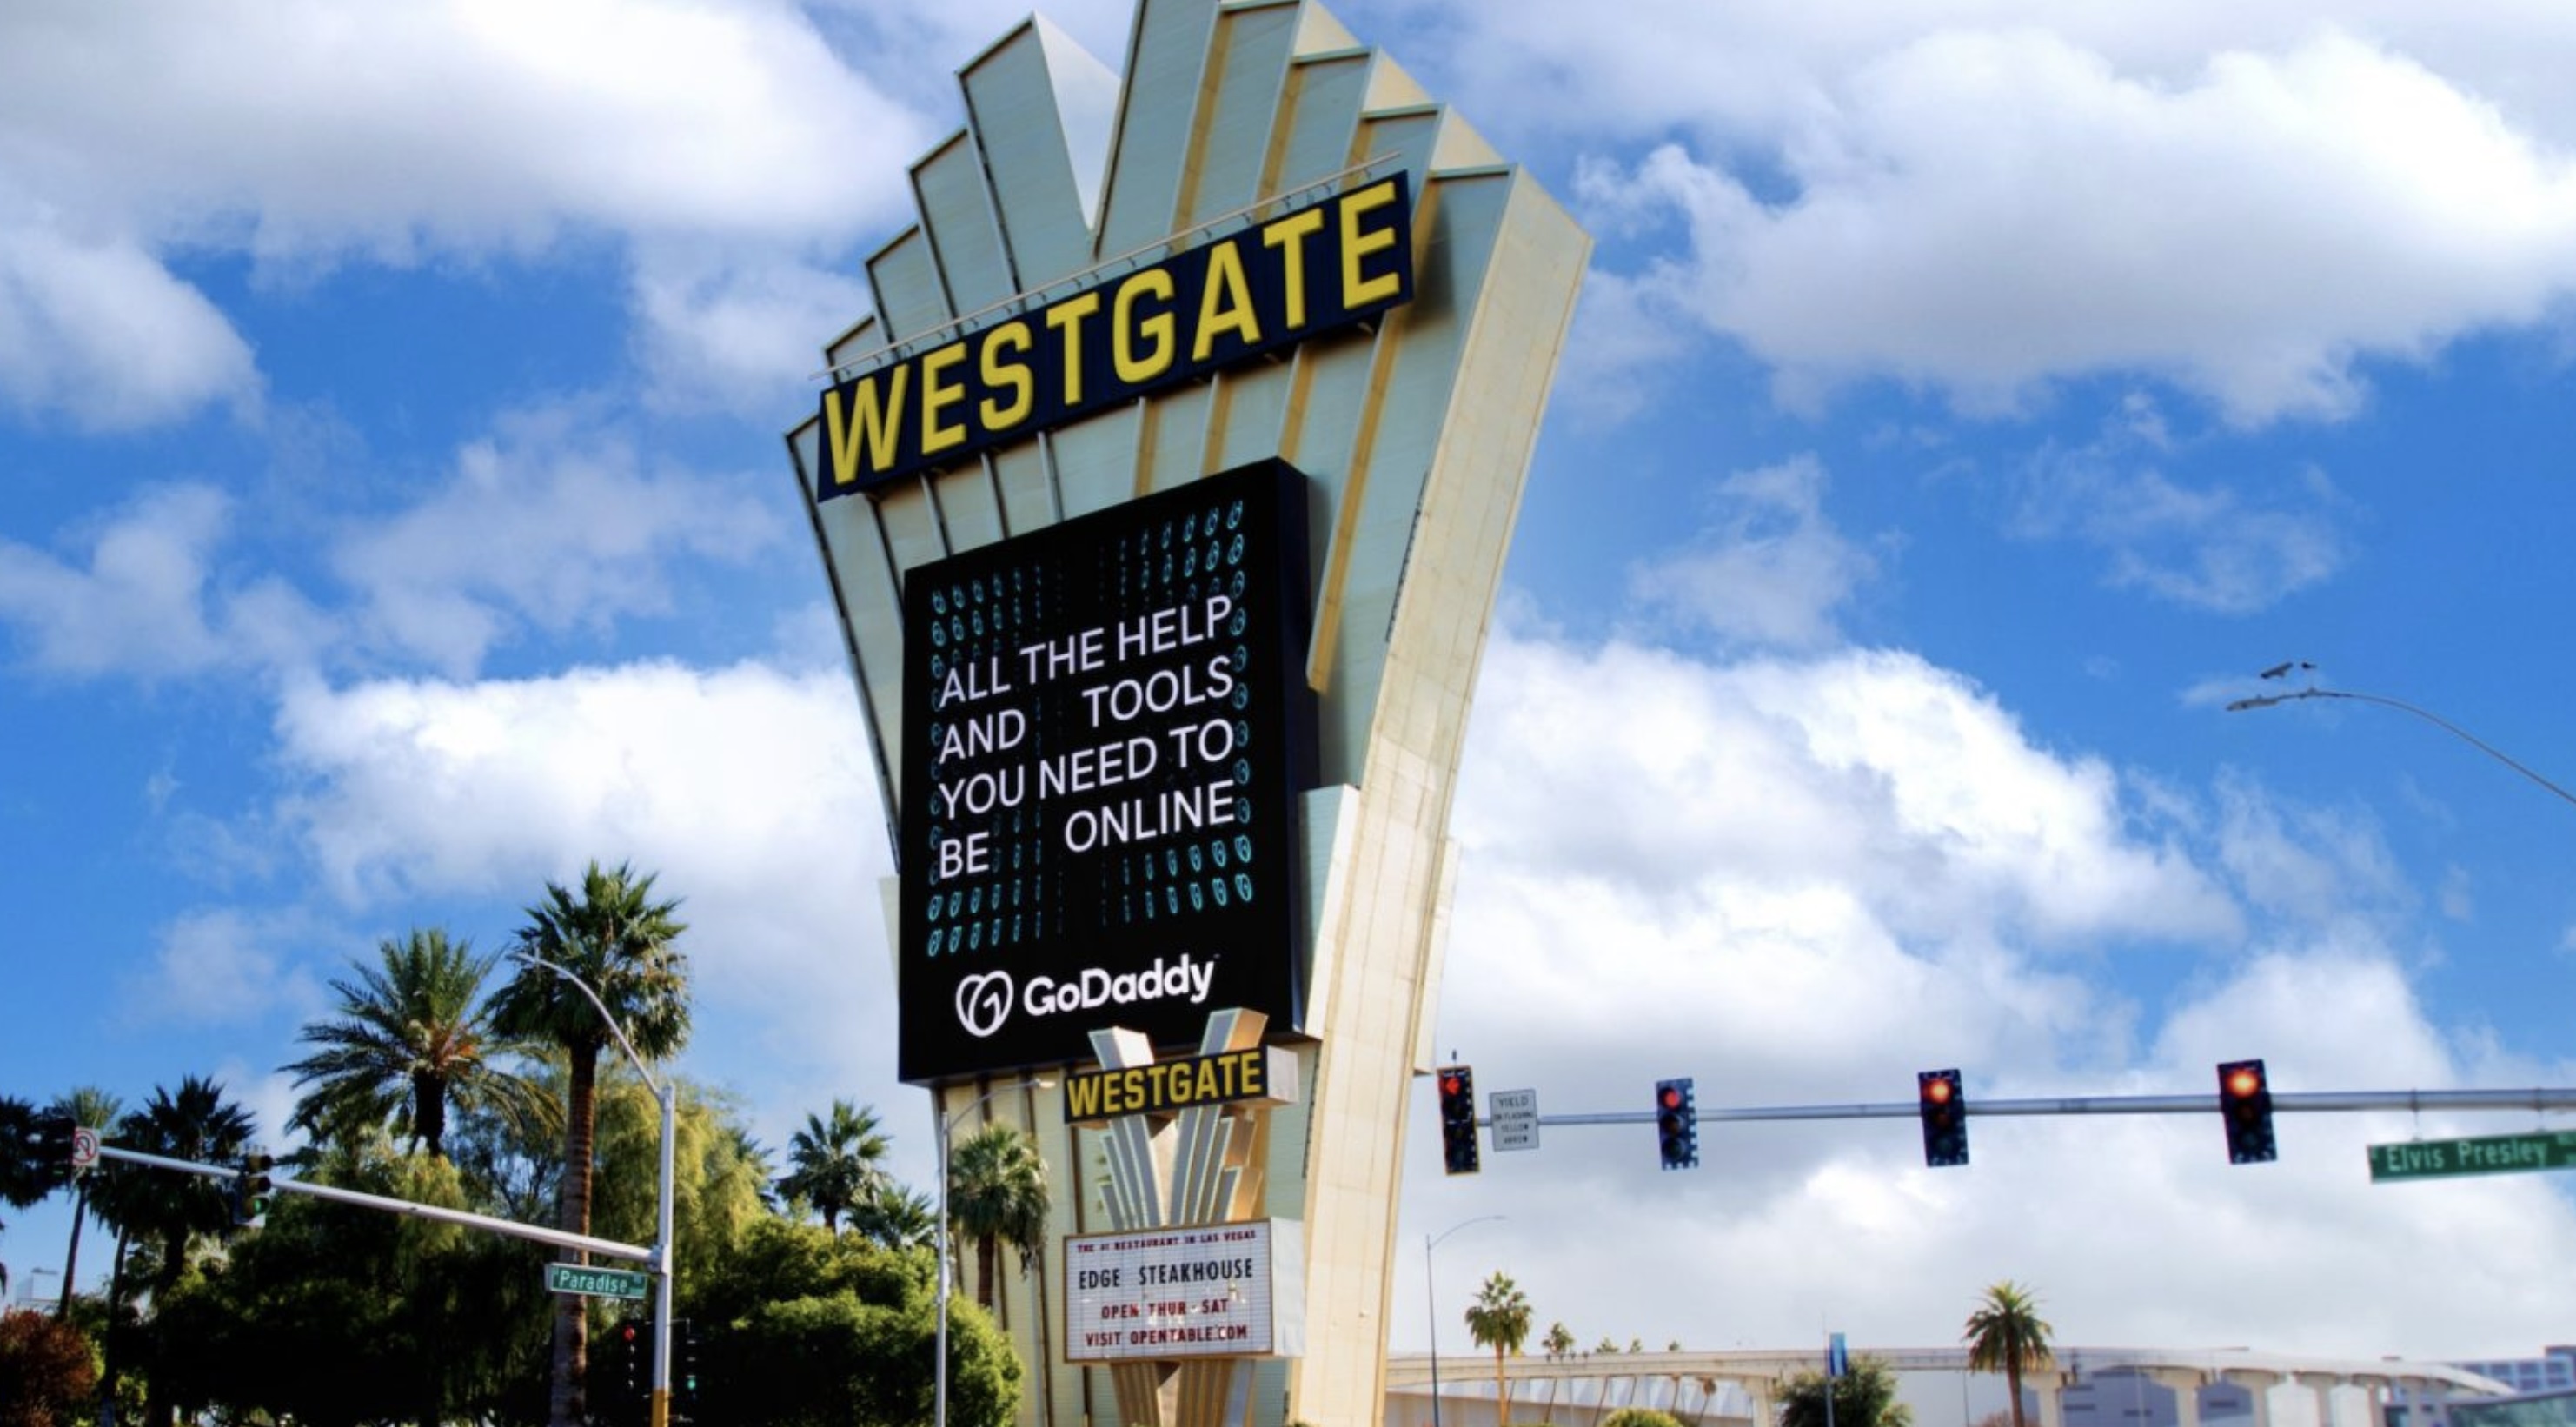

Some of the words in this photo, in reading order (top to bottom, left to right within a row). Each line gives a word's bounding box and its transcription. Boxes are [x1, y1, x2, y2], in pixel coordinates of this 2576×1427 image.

[825, 181, 1401, 485] WESTGATE
[939, 662, 1010, 707] ALL
[1020, 628, 1105, 684] THE
[1118, 595, 1232, 662] HELP
[939, 709, 1026, 764] AND
[1083, 656, 1233, 728] TOOLS
[939, 766, 1025, 820] YOU
[1039, 737, 1157, 799] NEED
[1169, 720, 1234, 769] TO
[939, 832, 990, 879] BE
[1065, 780, 1235, 853] ONLINE
[1024, 953, 1215, 1016] GoDaddy
[1067, 1052, 1263, 1118] WESTGATE
[1499, 1095, 1529, 1108] YIELD
[2387, 1144, 2446, 1172] Elvis
[2457, 1137, 2548, 1169] Presley
[1078, 1244, 1094, 1253] THE
[1114, 1237, 1179, 1251] RESTAURANT
[1185, 1235, 1196, 1244] IN
[1200, 1232, 1219, 1243] LAS
[1224, 1230, 1256, 1241] VEGAS
[559, 1270, 628, 1293] Paradise
[1079, 1268, 1121, 1290] EDGE
[1139, 1258, 1253, 1286] STEAKHOUSE
[1101, 1304, 1139, 1319] OPEN
[1148, 1300, 1186, 1317] THUR
[1201, 1298, 1229, 1314] SAT
[1086, 1331, 1121, 1346] VISIT
[1130, 1324, 1248, 1345] OPENTABLE.COM
